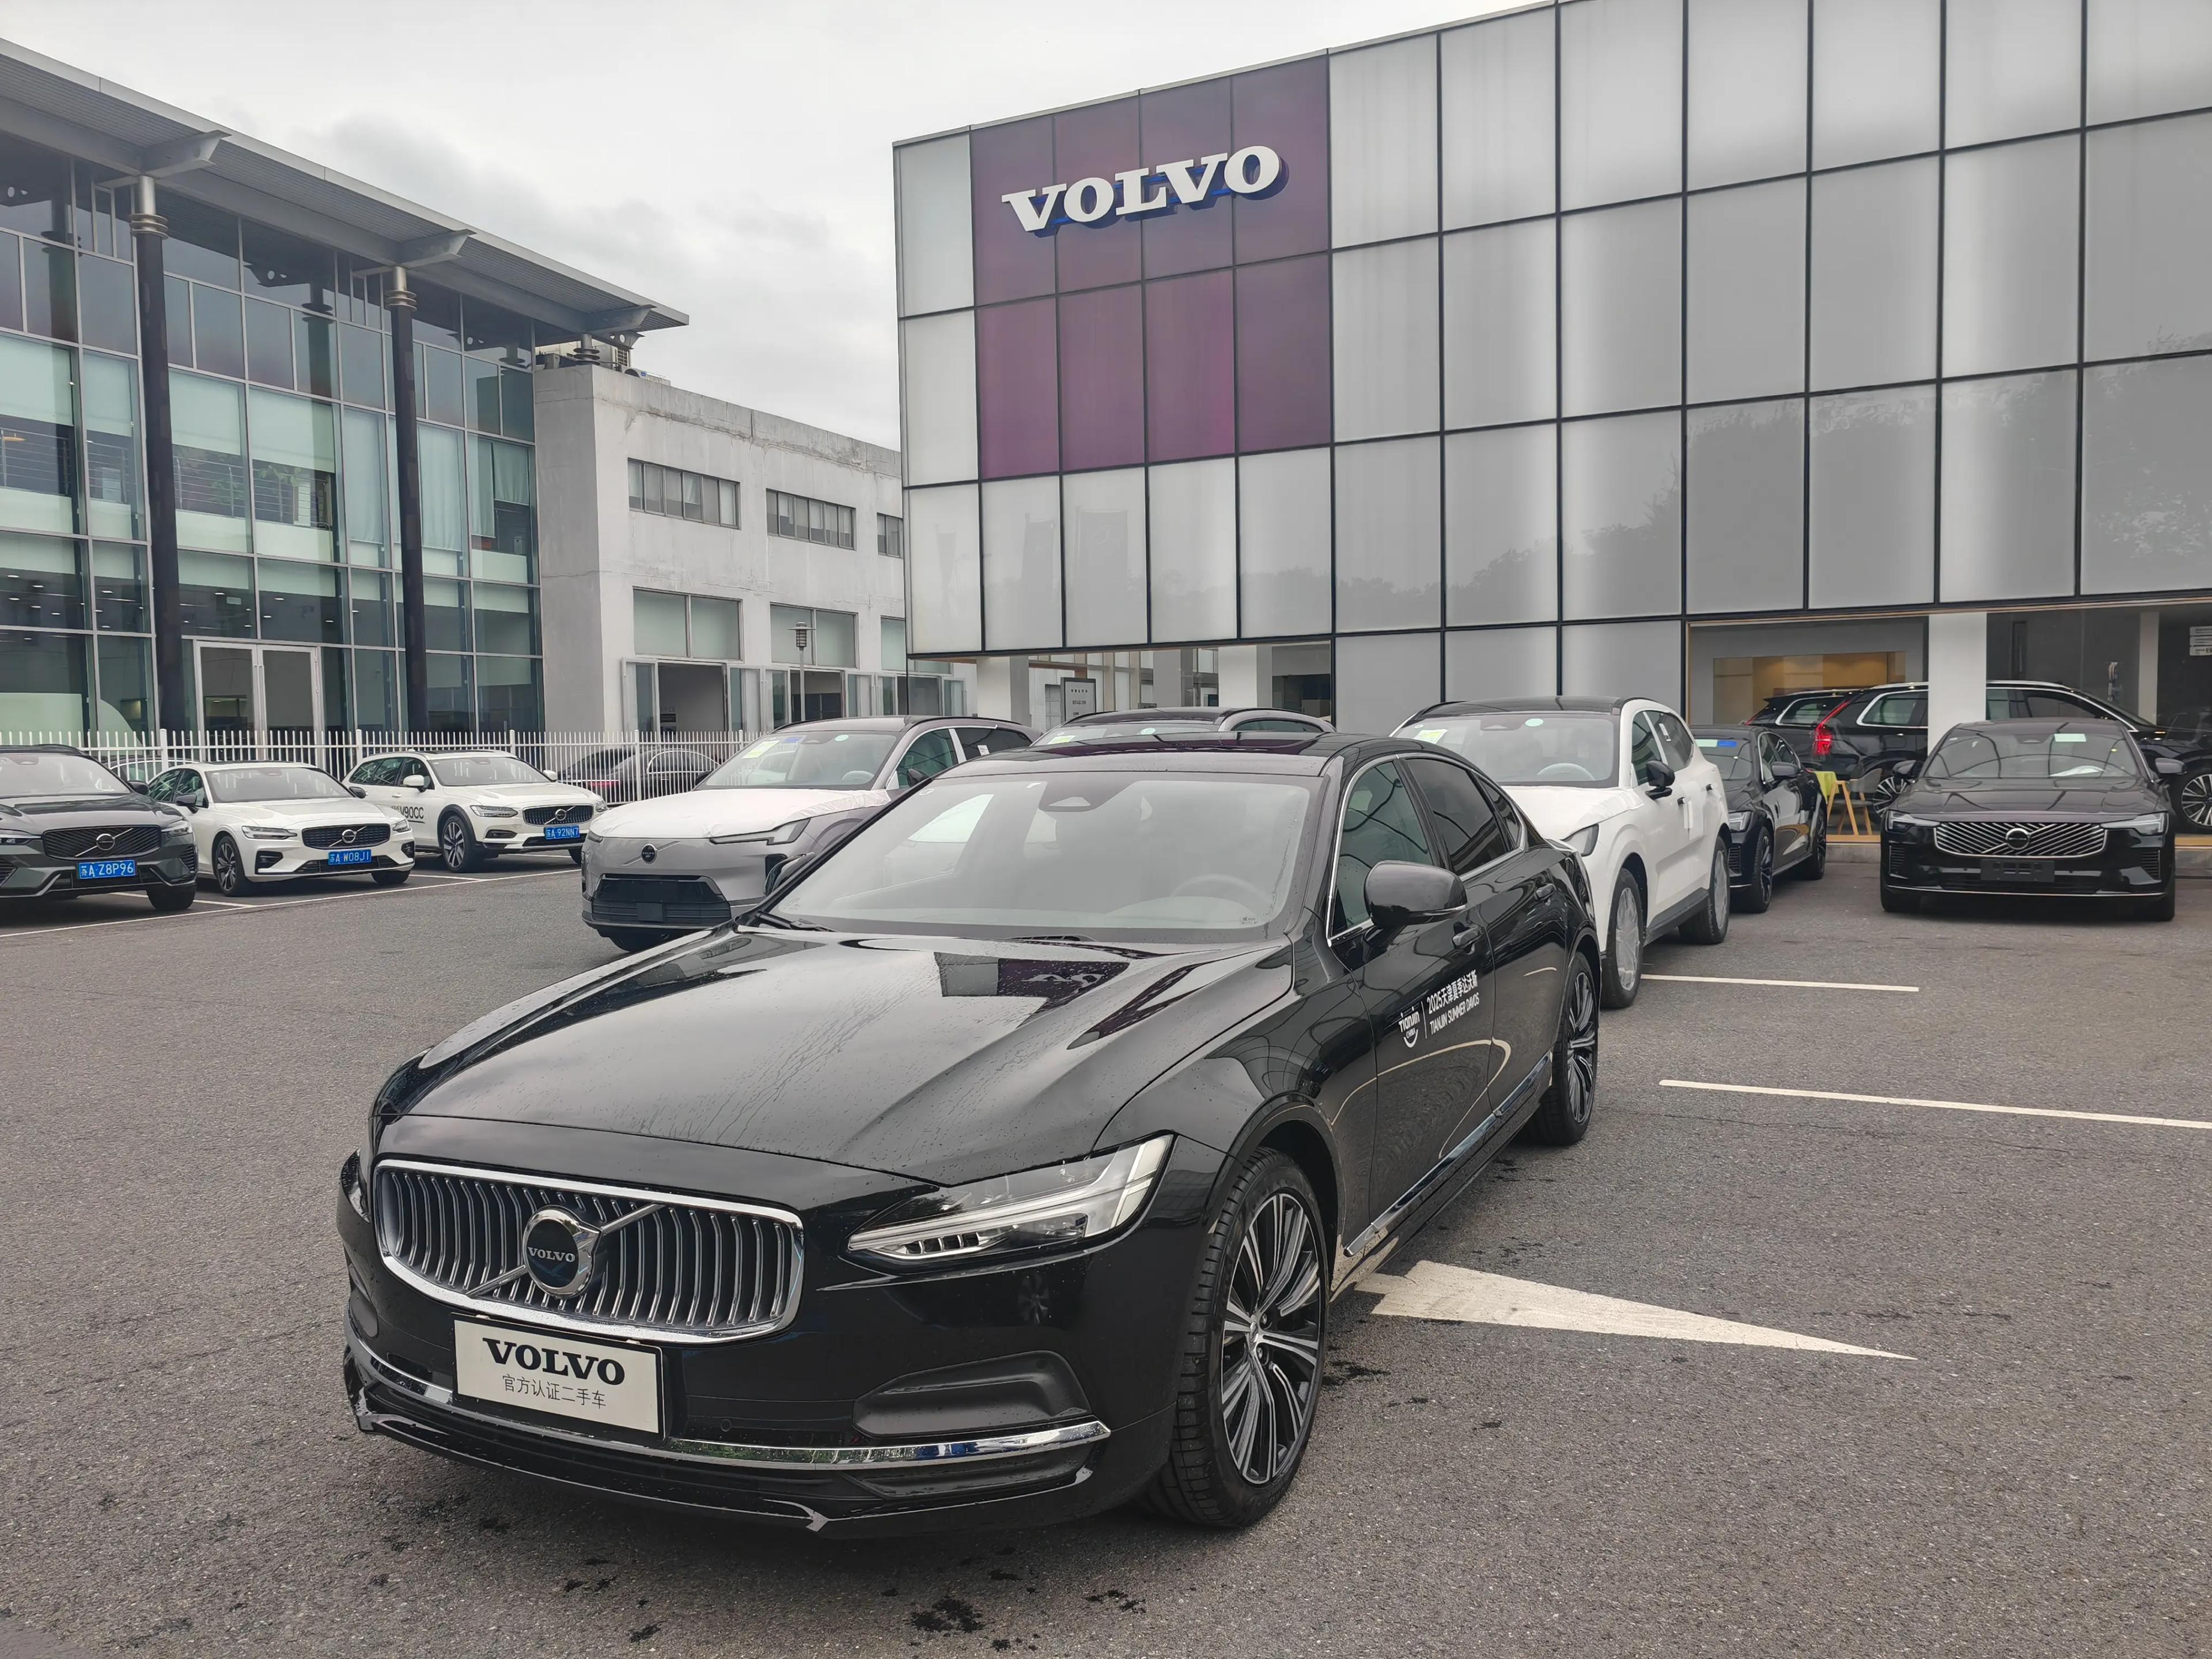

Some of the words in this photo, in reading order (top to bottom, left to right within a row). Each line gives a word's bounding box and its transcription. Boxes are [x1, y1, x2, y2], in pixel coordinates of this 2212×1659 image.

[1001, 145, 1280, 232] VOLVO
[400, 806, 424, 819] V90CC
[1426, 969, 1478, 1014] 2025天津夏季达沃斯
[1429, 1012, 1448, 1035] TIANJIN
[1447, 1001, 1467, 1024] SUMMER
[1465, 991, 1480, 1012] DAVOS
[527, 1247, 575, 1262] VOLVO
[482, 1338, 625, 1385] VOLVO
[502, 1373, 607, 1409] 官方认证二手车
